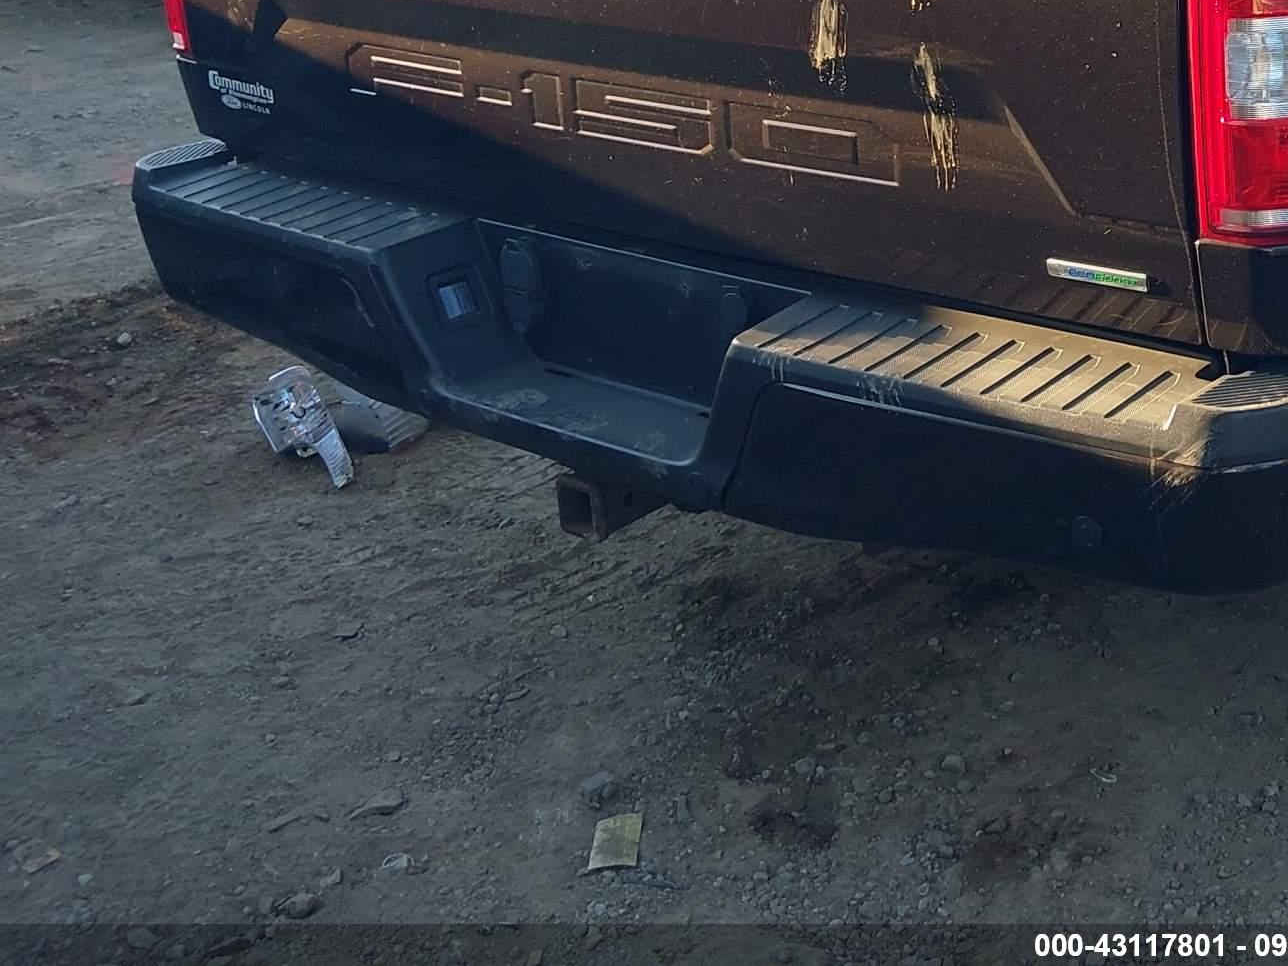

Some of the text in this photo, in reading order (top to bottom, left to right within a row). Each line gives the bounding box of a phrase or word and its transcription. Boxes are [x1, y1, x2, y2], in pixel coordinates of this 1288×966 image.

[208, 70, 274, 104] Community
[242, 102, 271, 115] LINCOLN
[348, 42, 899, 187] F-150
